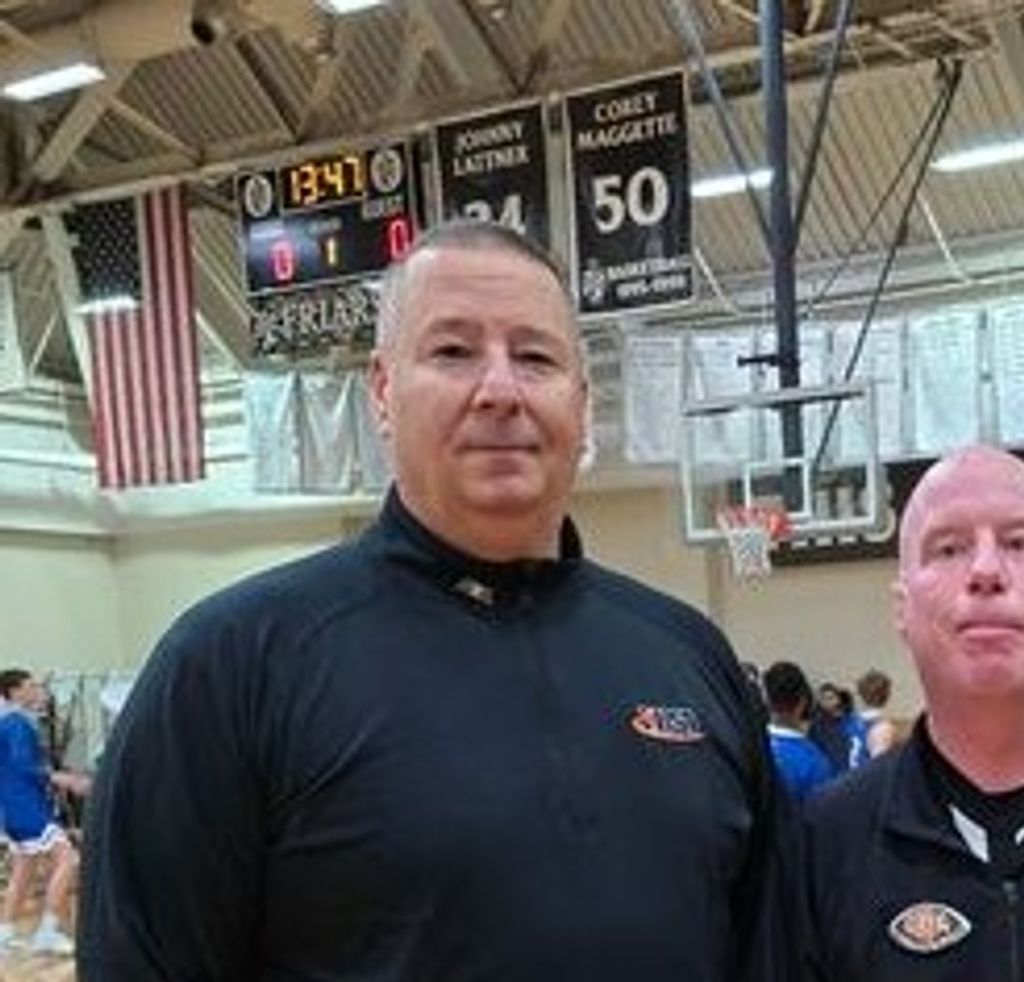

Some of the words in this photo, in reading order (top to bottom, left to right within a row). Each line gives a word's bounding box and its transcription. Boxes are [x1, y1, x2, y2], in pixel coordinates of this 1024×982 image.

[594, 91, 658, 123] COREY
[577, 111, 679, 149] MAGGETTE
[290, 157, 366, 205] 13:47
[592, 166, 670, 234] 50
